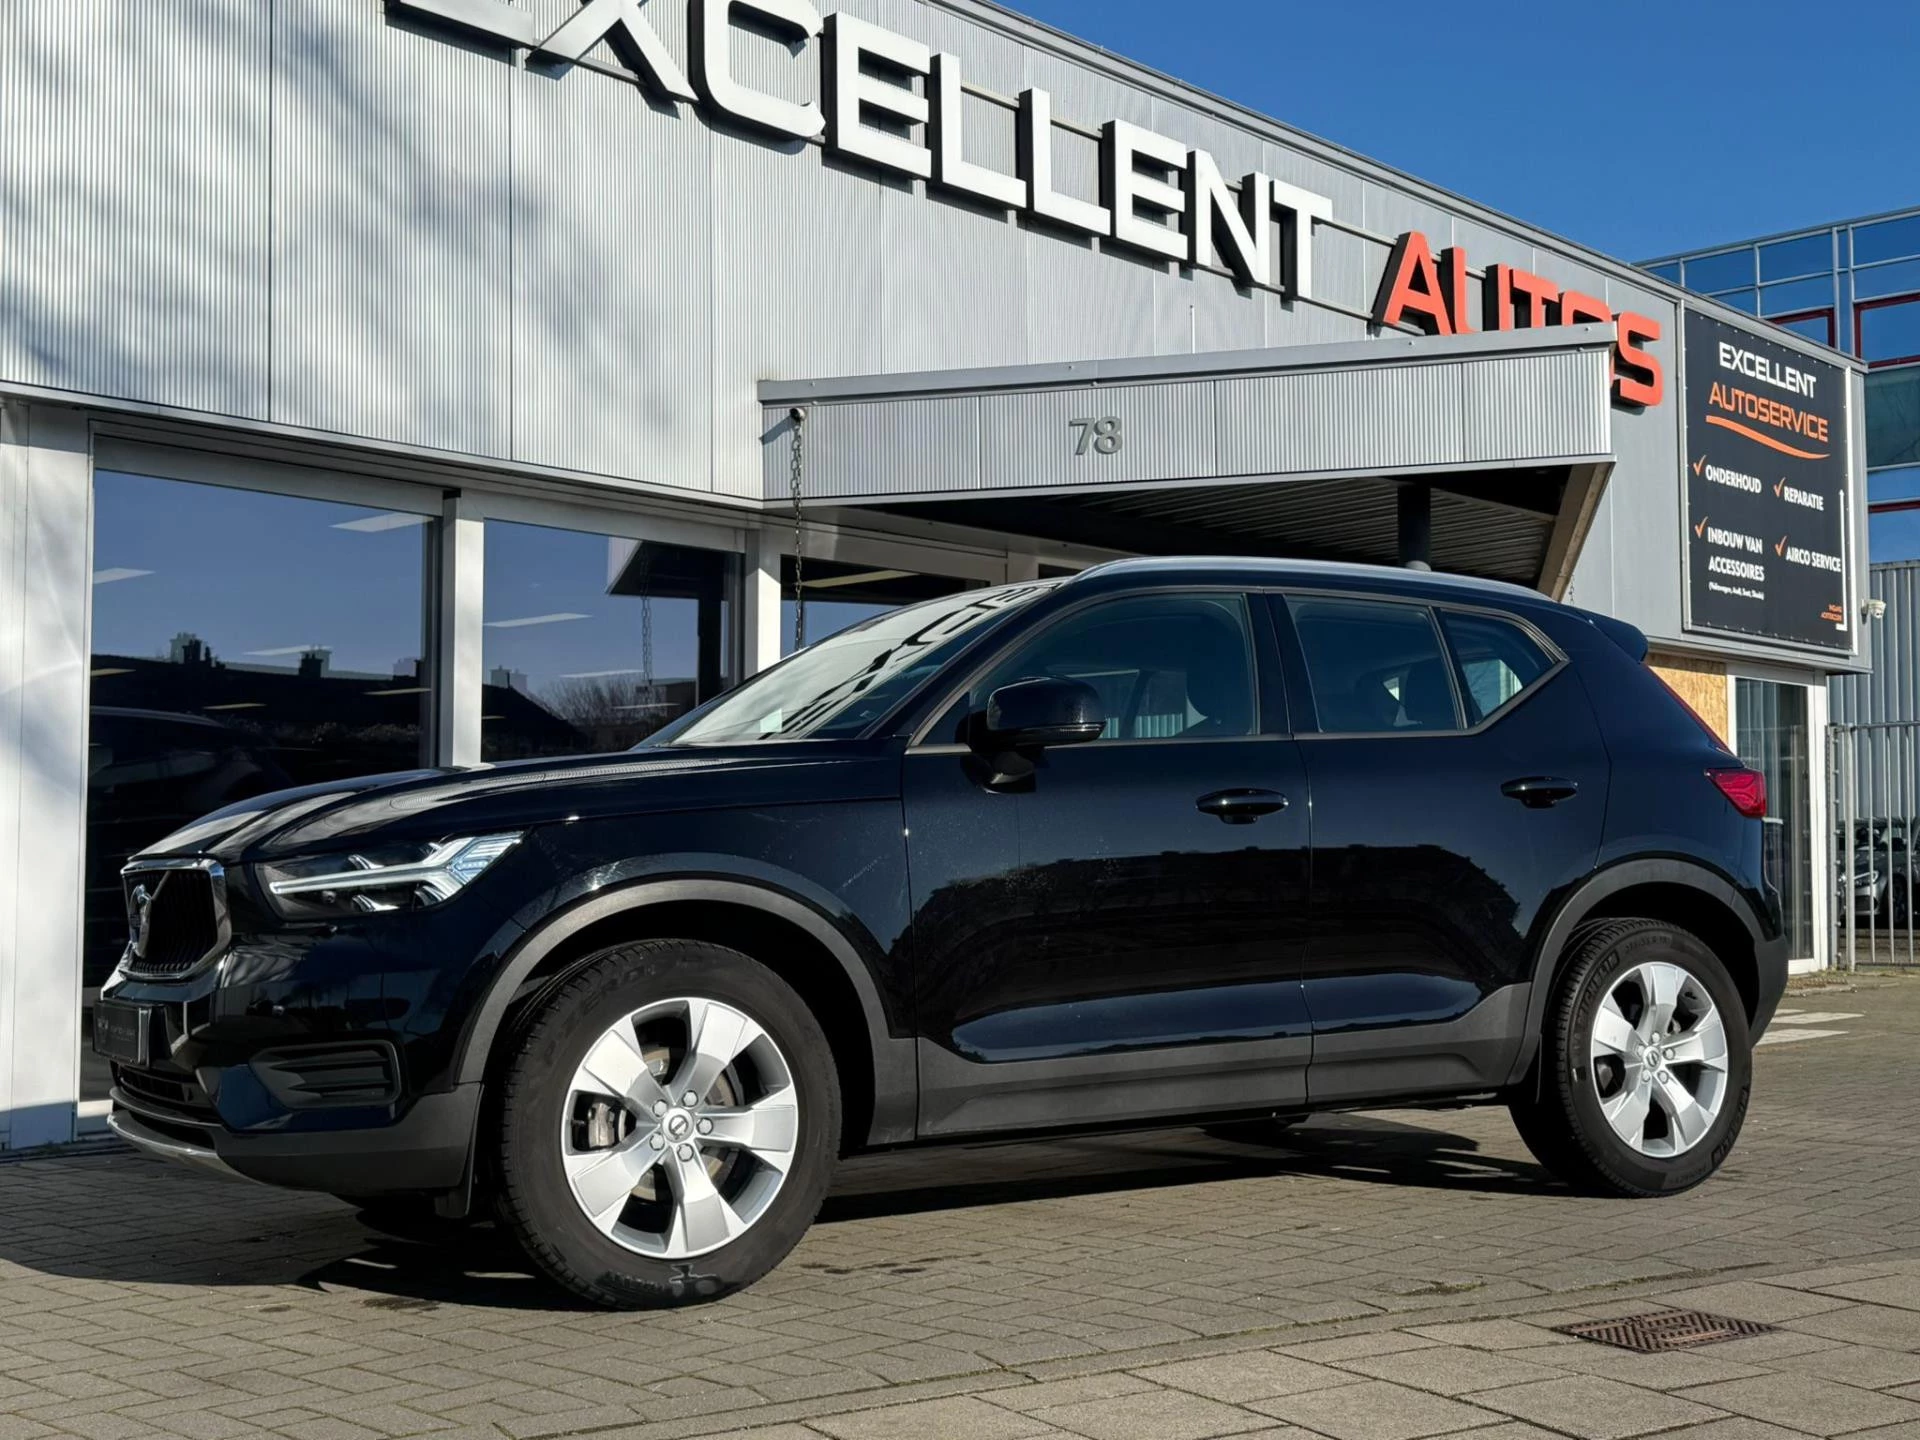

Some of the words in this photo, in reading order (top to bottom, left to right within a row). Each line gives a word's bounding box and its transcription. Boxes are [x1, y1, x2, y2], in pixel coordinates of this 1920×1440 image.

[384, 0, 1333, 300] XCELLENT
[1719, 342, 1816, 398] EXCELLENT
[1708, 381, 1829, 443] AUTOSERVICE
[1069, 416, 1123, 455] 78
[1705, 463, 1762, 494] ONDERHOUD
[1784, 485, 1824, 512] REPARATIE
[1707, 526, 1744, 551] INBOUW
[1744, 534, 1763, 554] VAN
[1708, 556, 1765, 582] ACCESSOIRES
[1785, 545, 1811, 567] AIRCO
[1811, 551, 1842, 573] SERVICE
